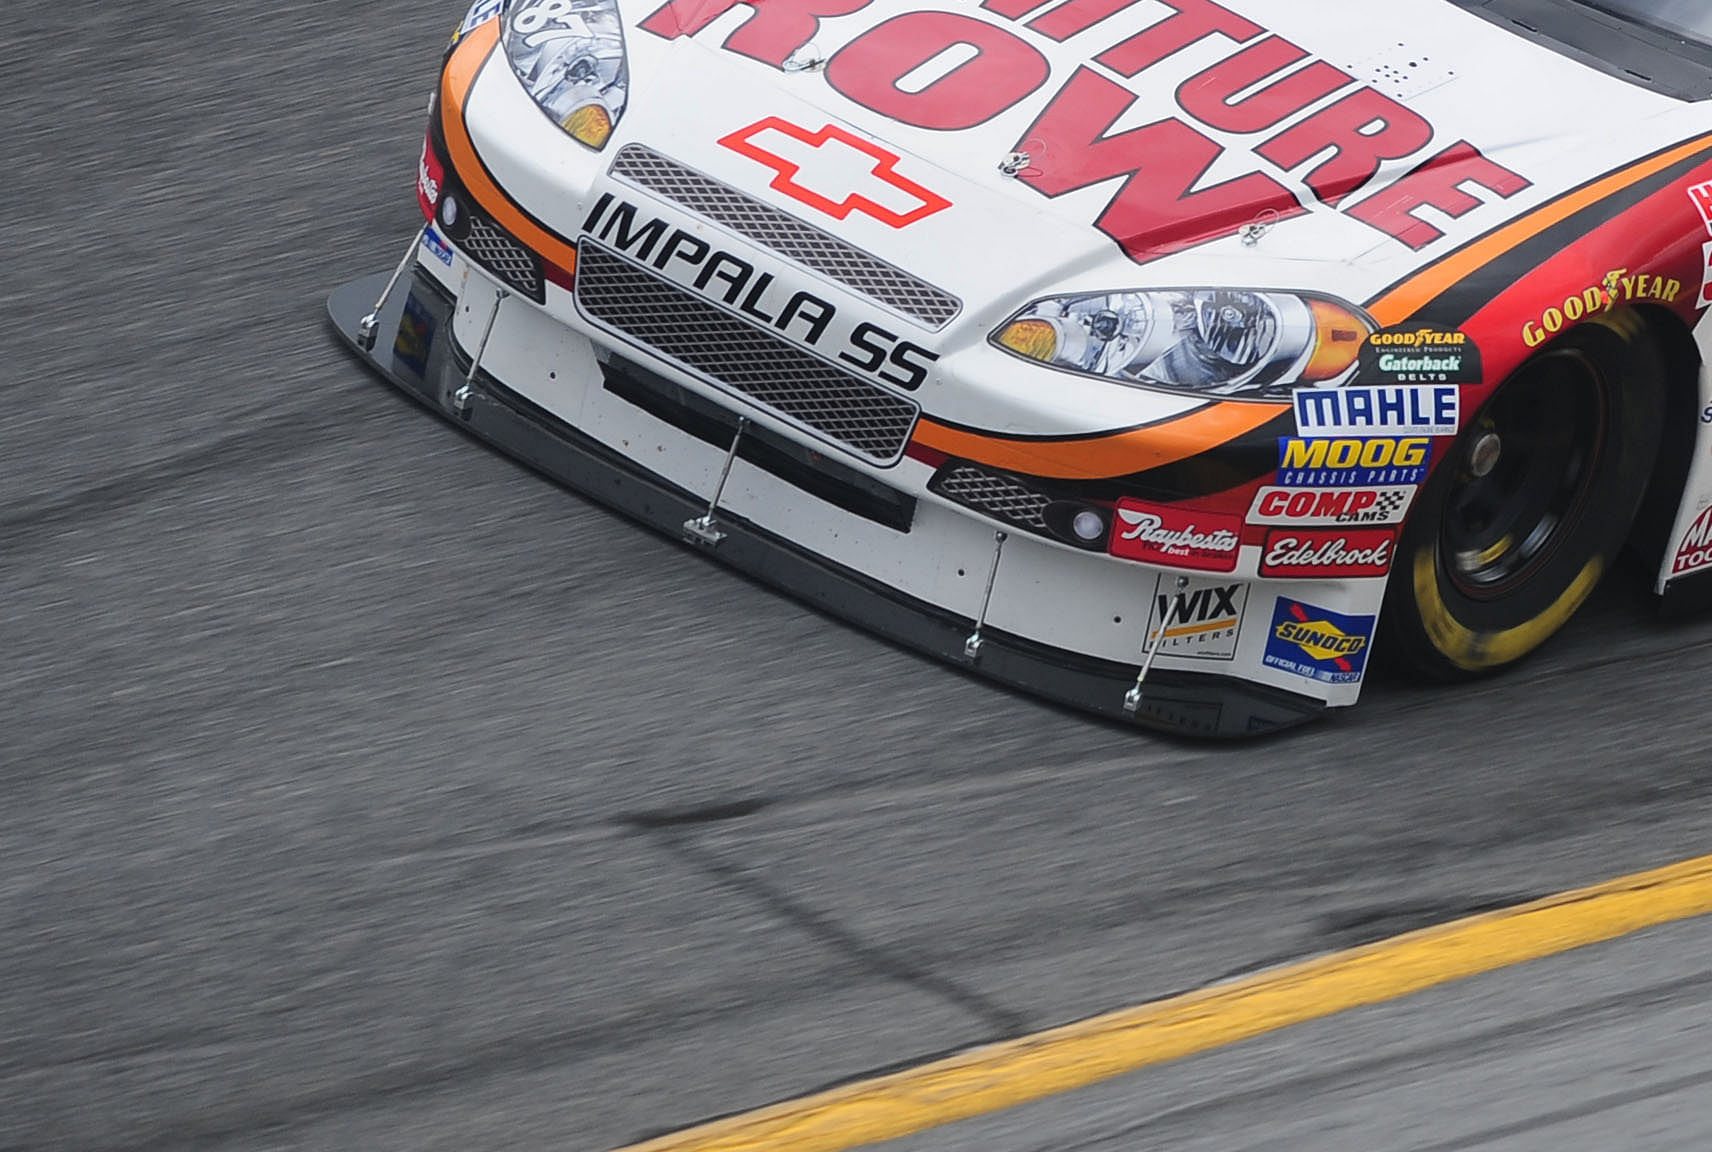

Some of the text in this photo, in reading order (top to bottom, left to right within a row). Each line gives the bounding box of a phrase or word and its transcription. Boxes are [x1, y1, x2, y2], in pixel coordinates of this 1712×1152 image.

[581, 192, 942, 392] IMPALA SS
[1522, 268, 1681, 347] GOODYEAR
[1369, 328, 1465, 348] GOODYEAR
[1378, 353, 1461, 372] Gatorback
[1299, 387, 1457, 426] MAHLE
[1281, 437, 1431, 469] MOOG
[1284, 468, 1419, 485] CHASSIS PARTS
[1258, 490, 1378, 518] COMP
[1334, 510, 1390, 523] CAMS
[1117, 508, 1239, 552] Raybestos
[1167, 546, 1190, 557] best
[1264, 537, 1391, 567] Edelbrock
[1157, 583, 1244, 626] WIX
[1278, 623, 1364, 653] SUNOCO
